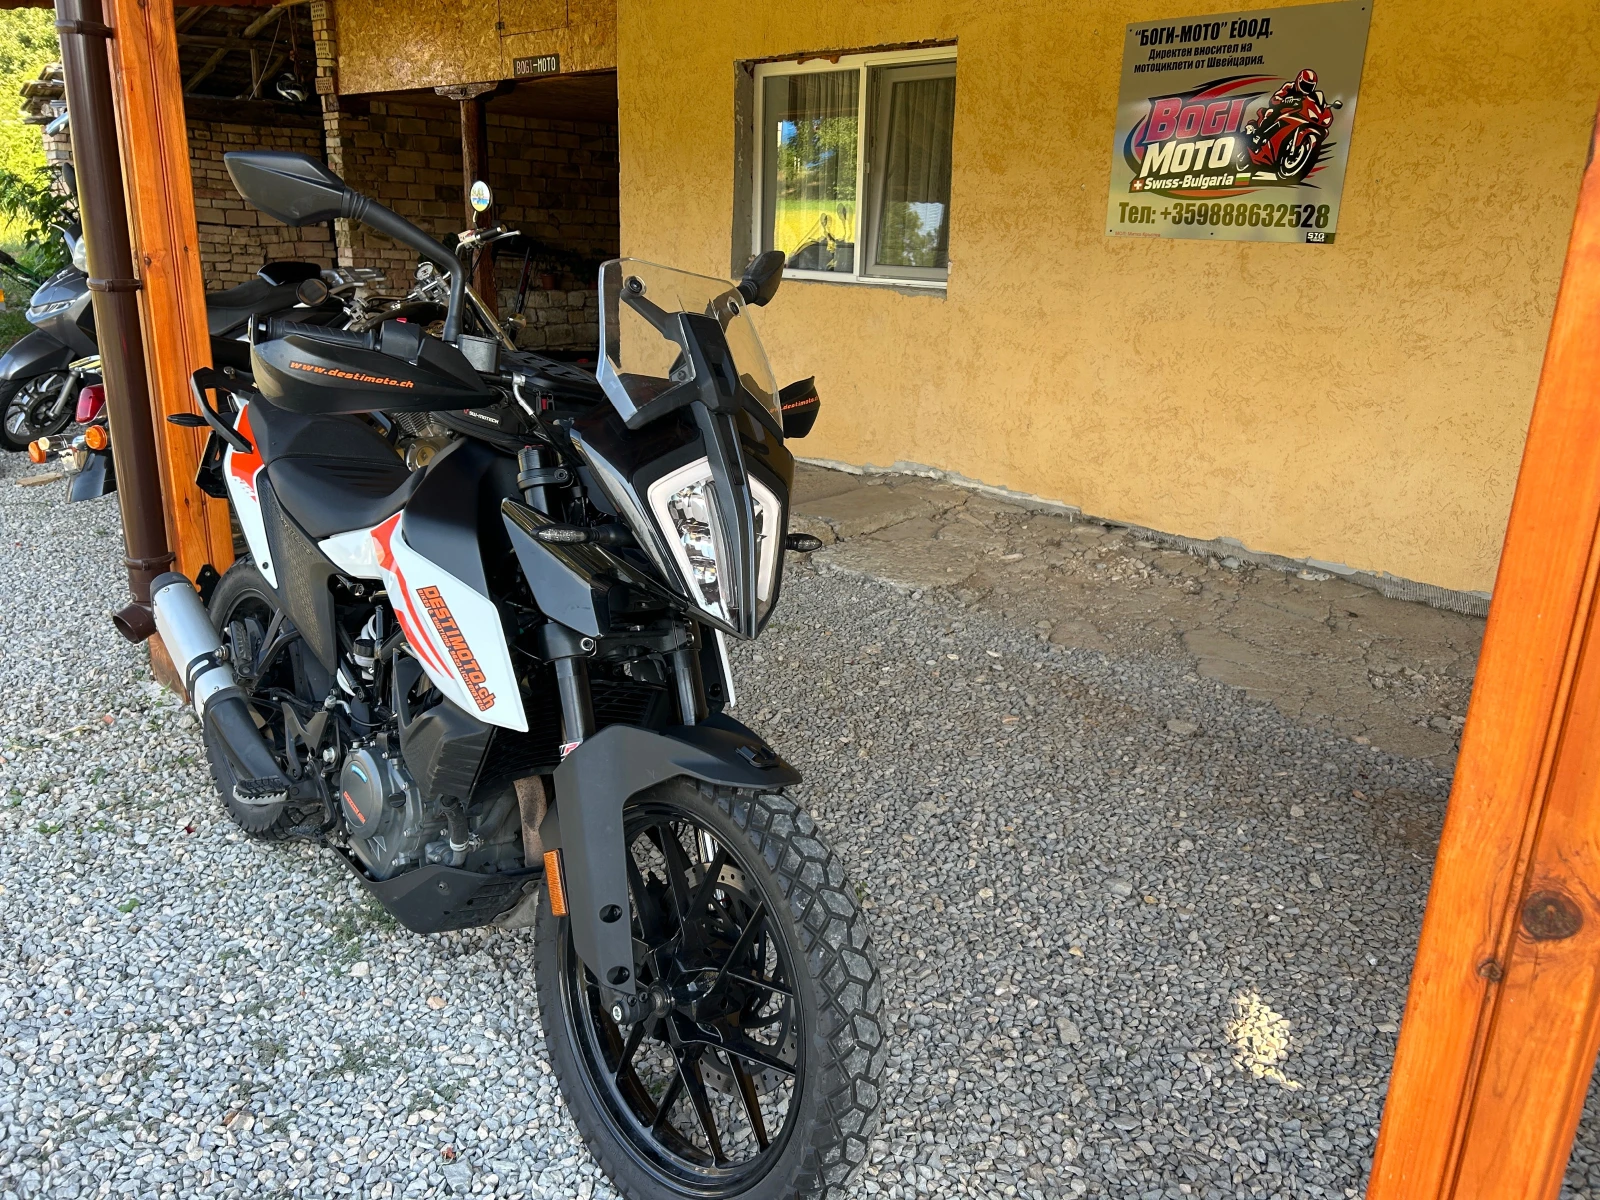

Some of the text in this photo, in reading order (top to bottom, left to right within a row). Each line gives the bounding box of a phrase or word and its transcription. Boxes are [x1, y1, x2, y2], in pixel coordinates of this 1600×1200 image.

[1134, 55, 1265, 73] мотоциклети от Швейцария.
[1148, 42, 1252, 61] Директен вносител на
[1139, 136, 1235, 178] MOTO
[1118, 201, 1330, 229] Тел: +359888632528
[289, 361, 414, 388] www.destimoto.ch
[422, 585, 496, 711] DESTIMOTO.ch
